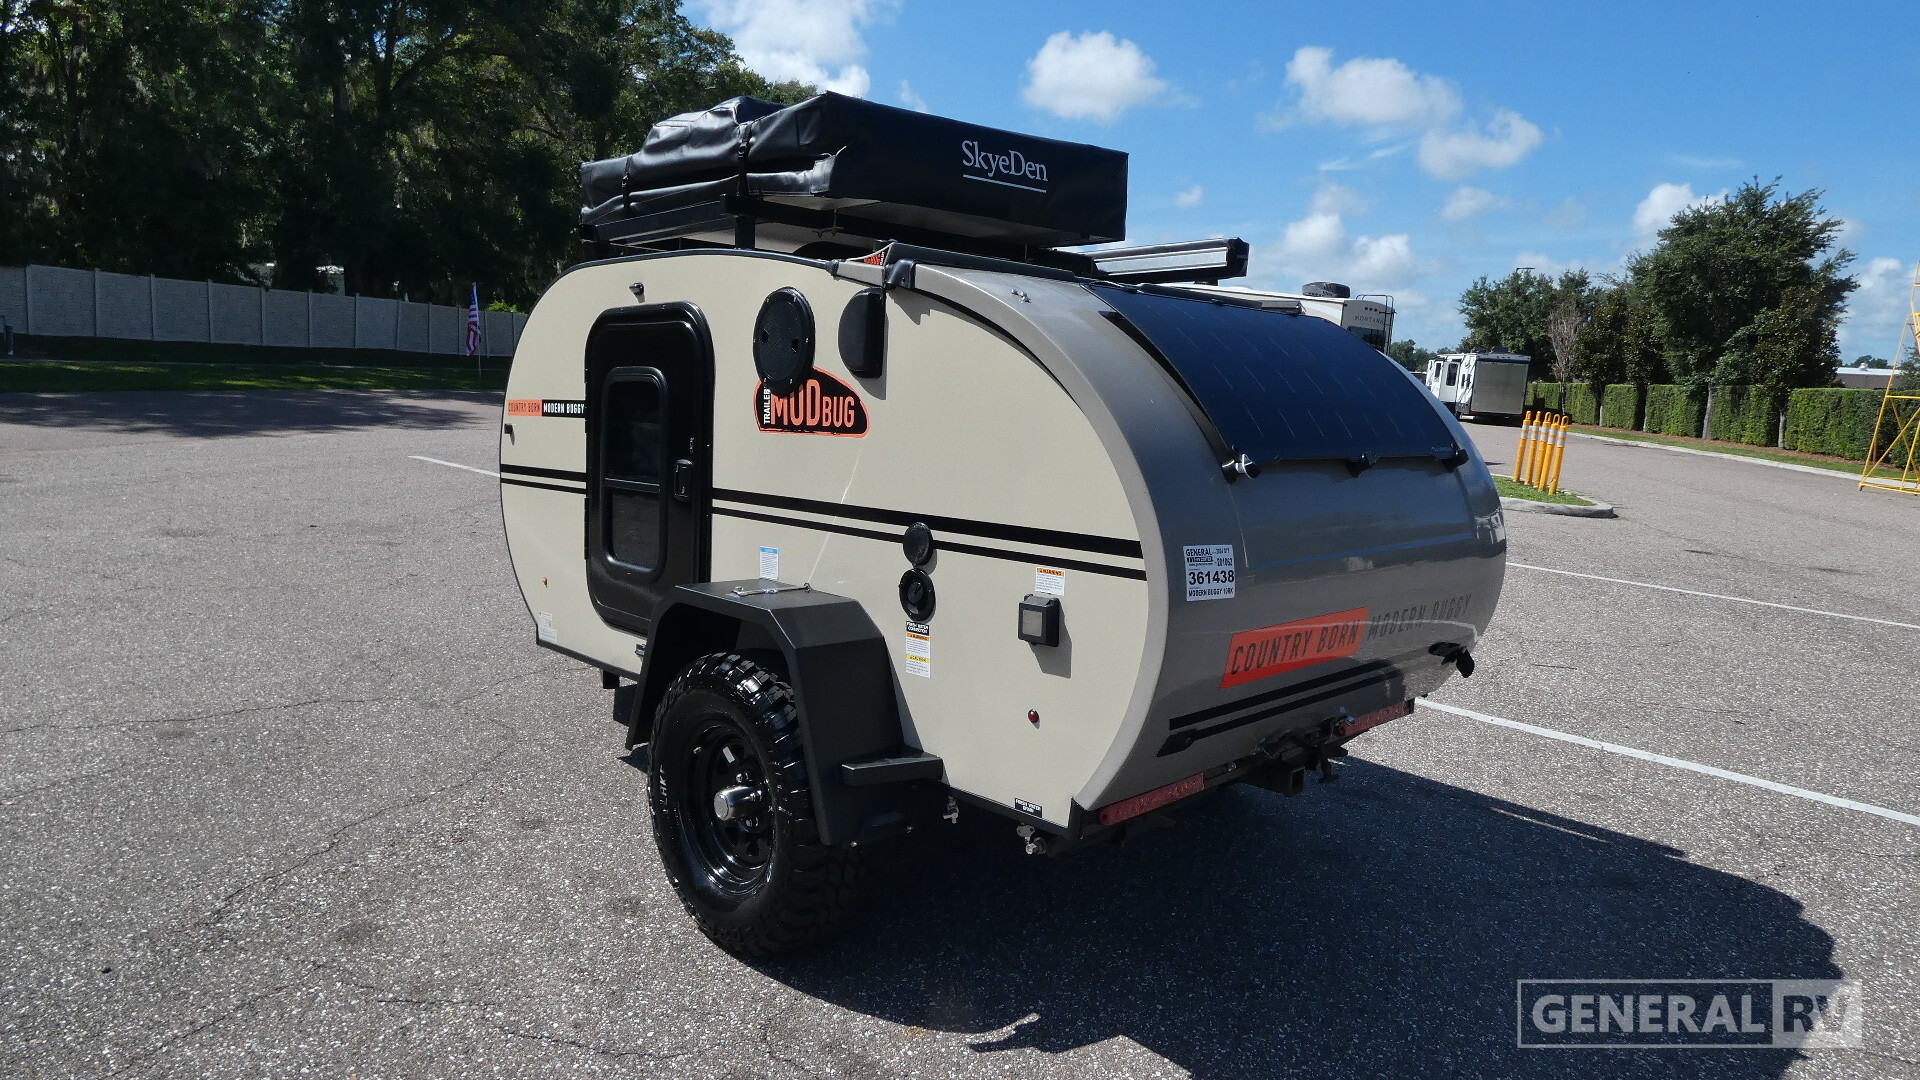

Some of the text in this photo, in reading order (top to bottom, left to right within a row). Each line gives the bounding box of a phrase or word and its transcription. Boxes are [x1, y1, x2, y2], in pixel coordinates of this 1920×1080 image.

[962, 140, 1048, 182] SkyeDen
[543, 402, 585, 415] MODERN BUGGY
[1186, 548, 1212, 556] GENERAL
[1188, 570, 1234, 585] 361438
[1230, 593, 1473, 676] COUNTRY BORN MODERN BUGGY
